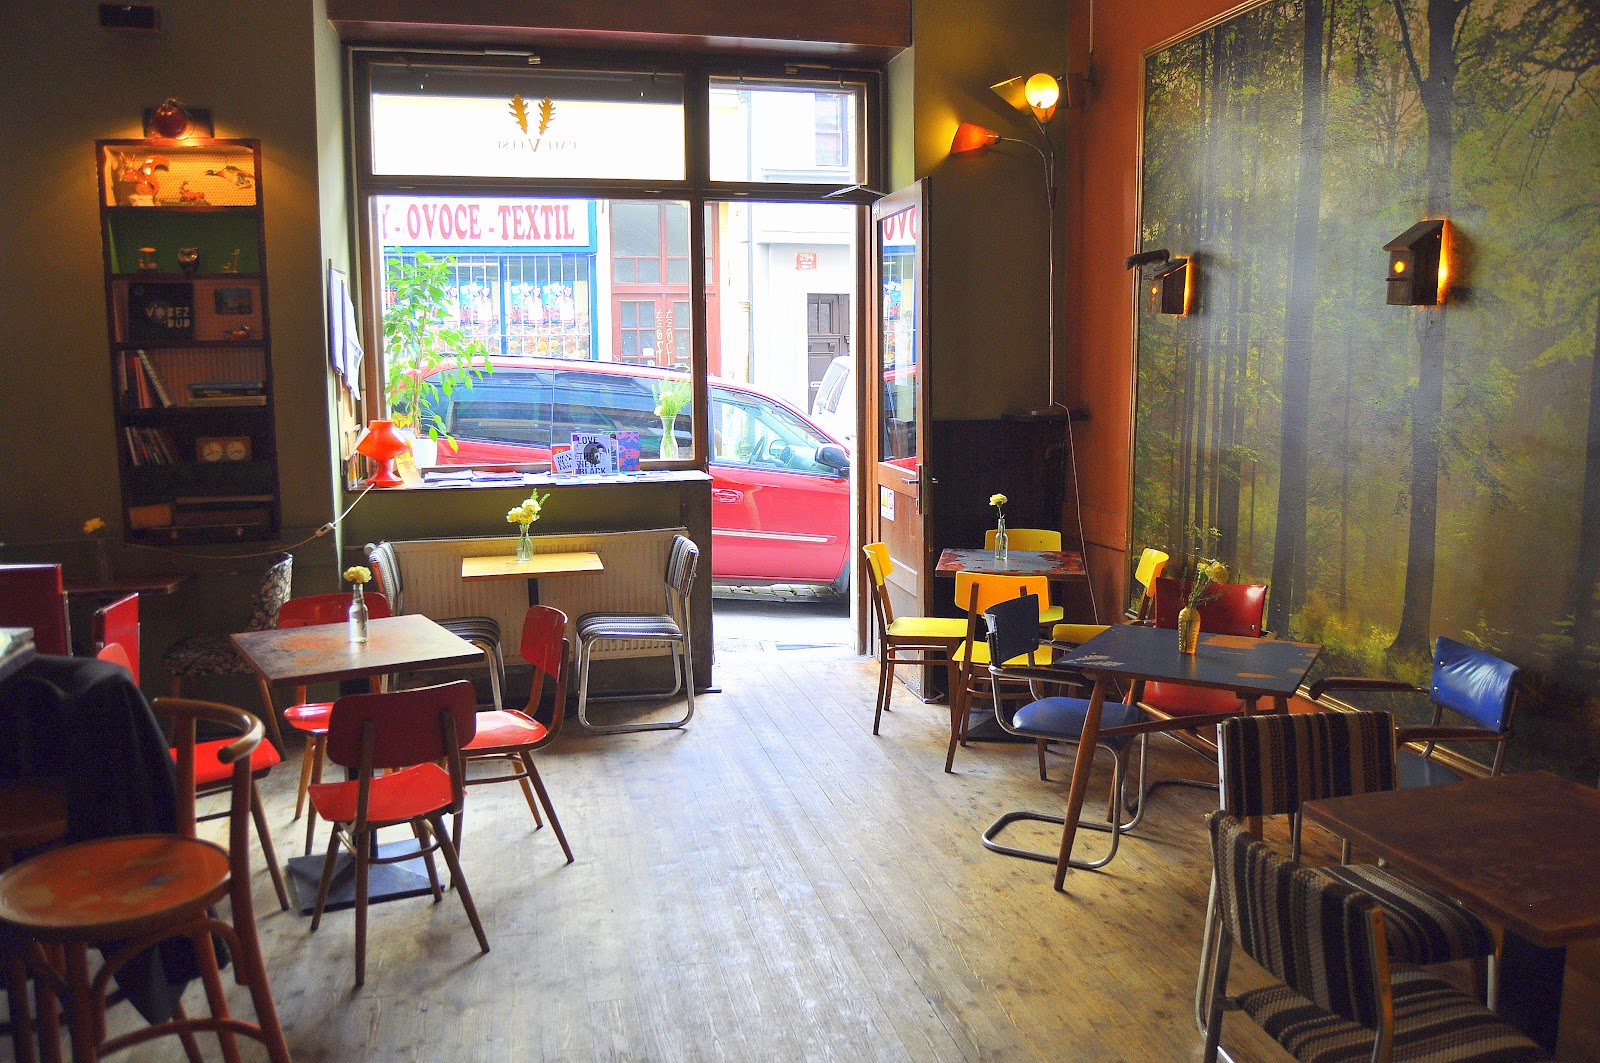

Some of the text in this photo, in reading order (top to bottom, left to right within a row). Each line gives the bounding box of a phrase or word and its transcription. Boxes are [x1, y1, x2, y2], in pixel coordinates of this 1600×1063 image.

[407, 203, 482, 240] OVOCE
[498, 204, 575, 241] TEXTIL
[577, 436, 598, 445] LOVE
